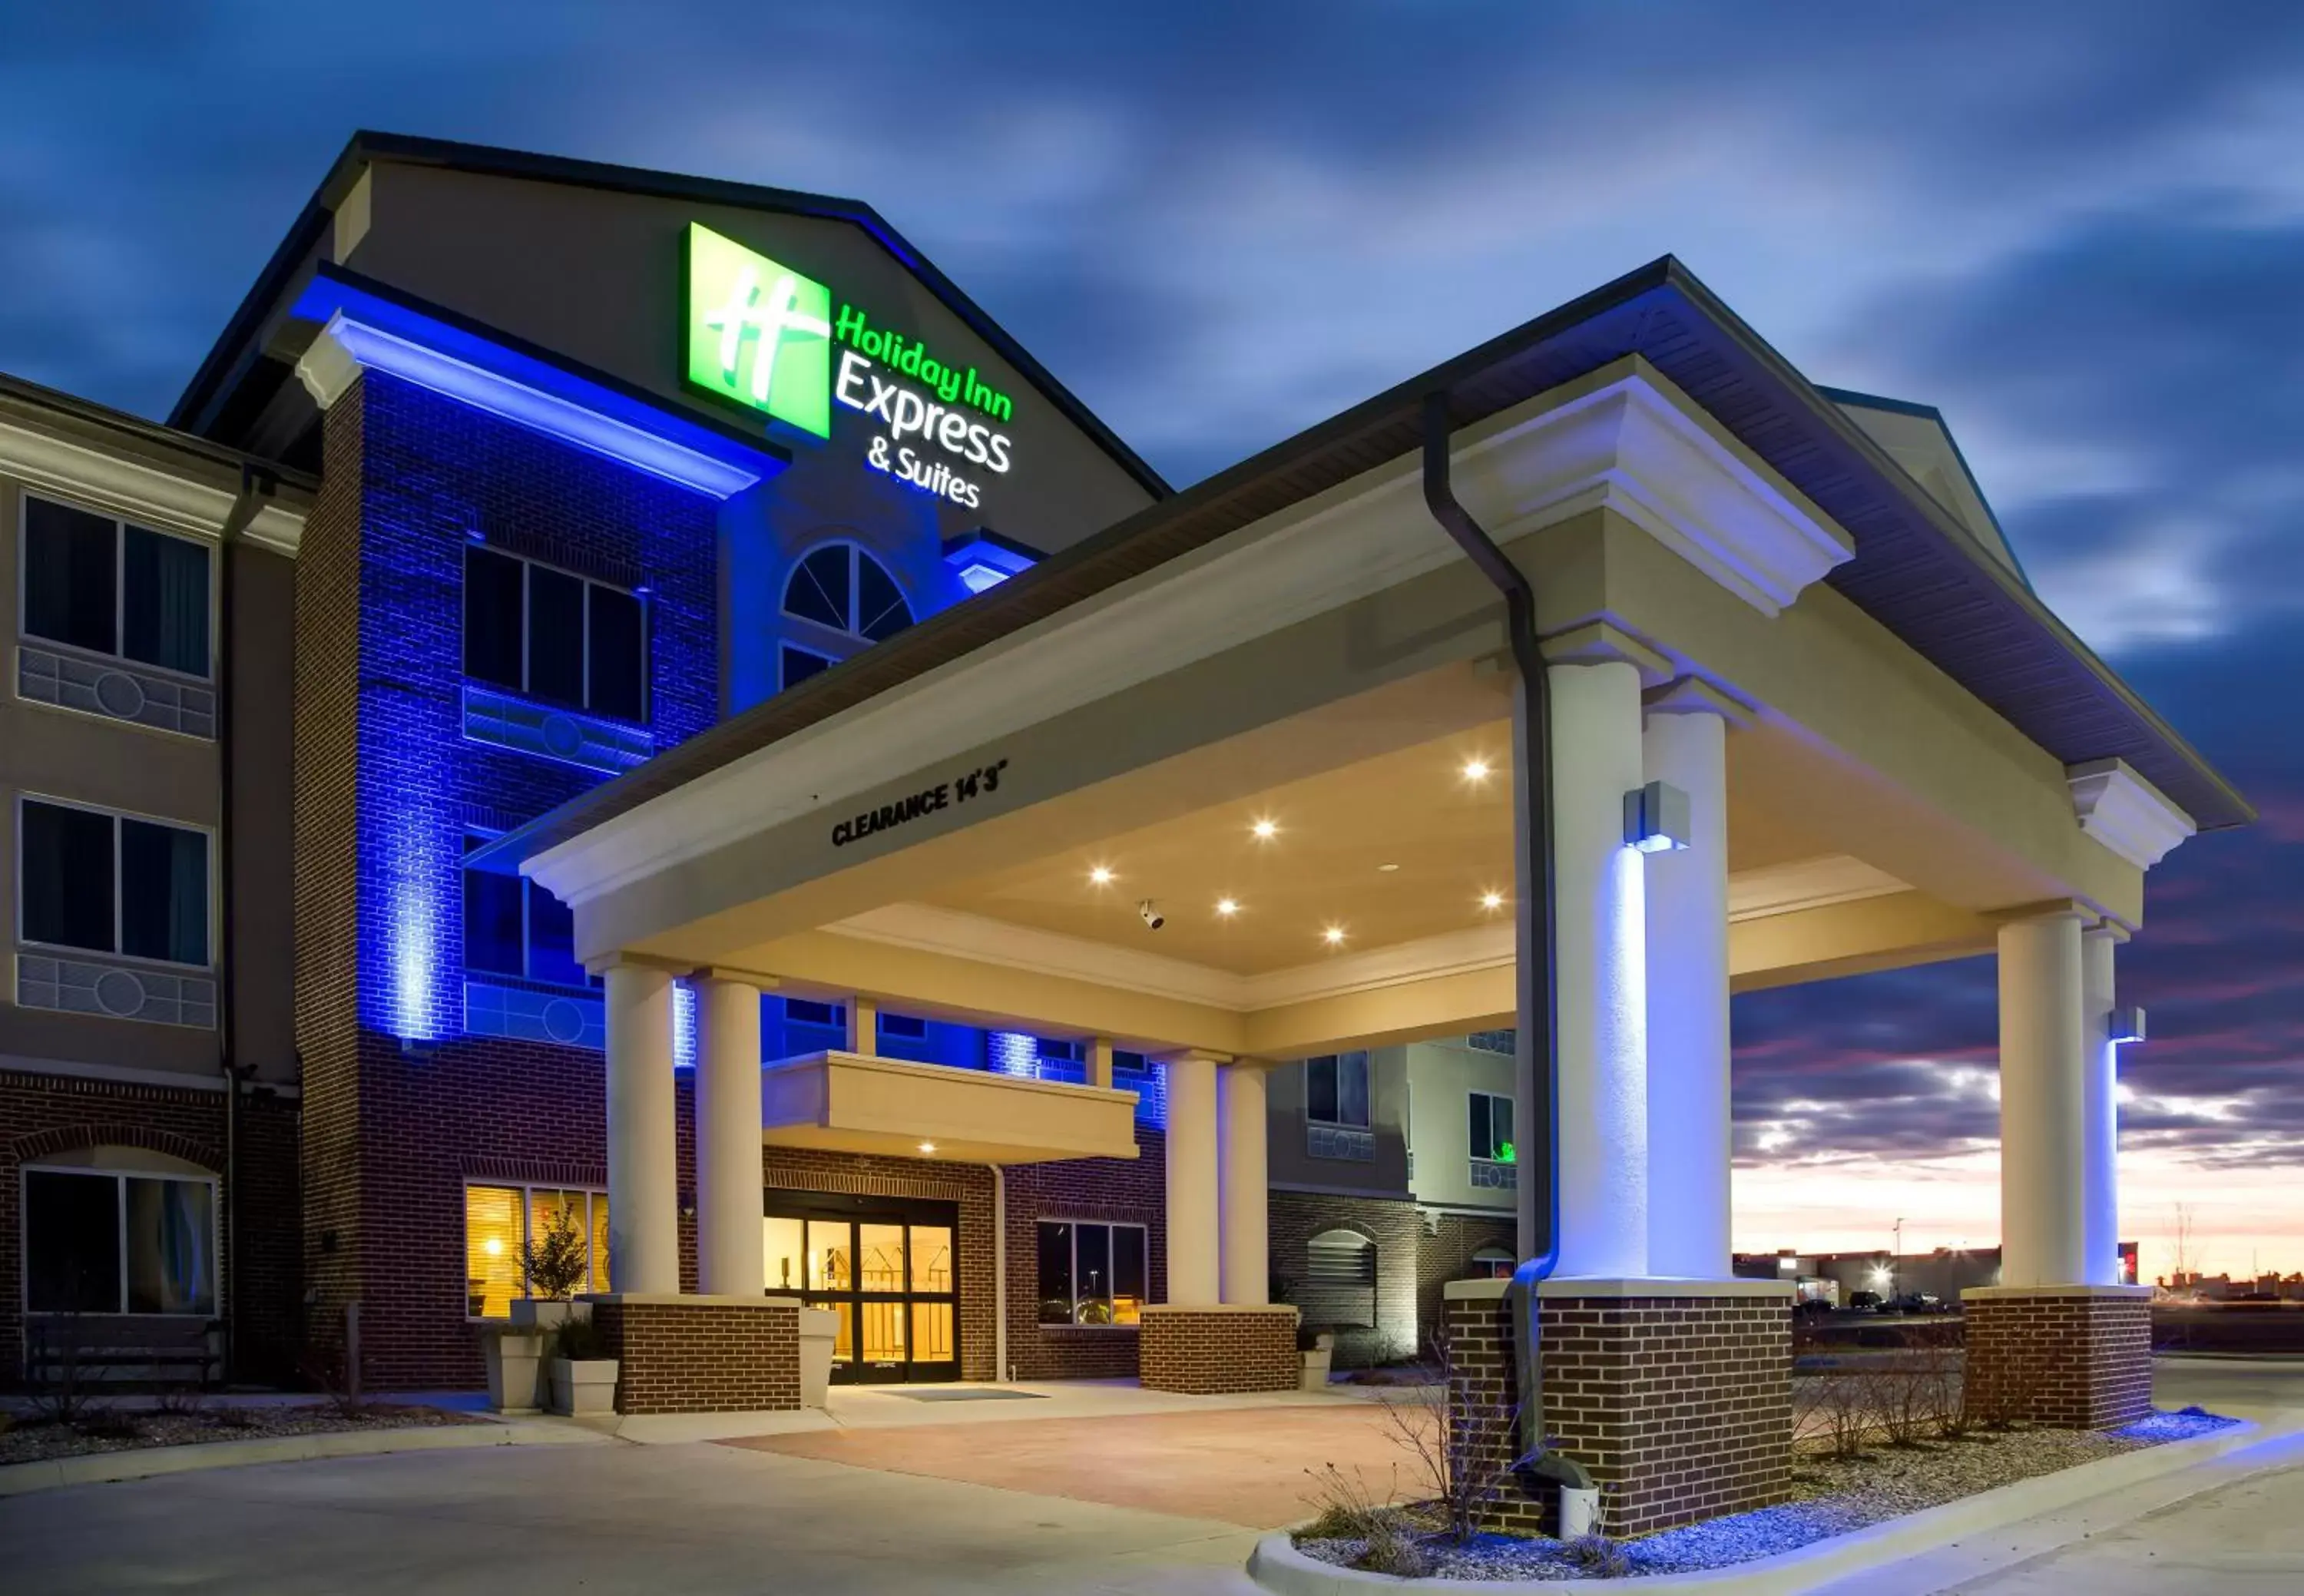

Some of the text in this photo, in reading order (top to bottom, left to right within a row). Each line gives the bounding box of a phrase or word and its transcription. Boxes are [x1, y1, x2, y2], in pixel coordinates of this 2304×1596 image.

[836, 304, 1012, 422] Holiday Inn
[836, 349, 1011, 473] Express
[868, 435, 980, 508] & Suites
[832, 783, 948, 846] CLEARANCE
